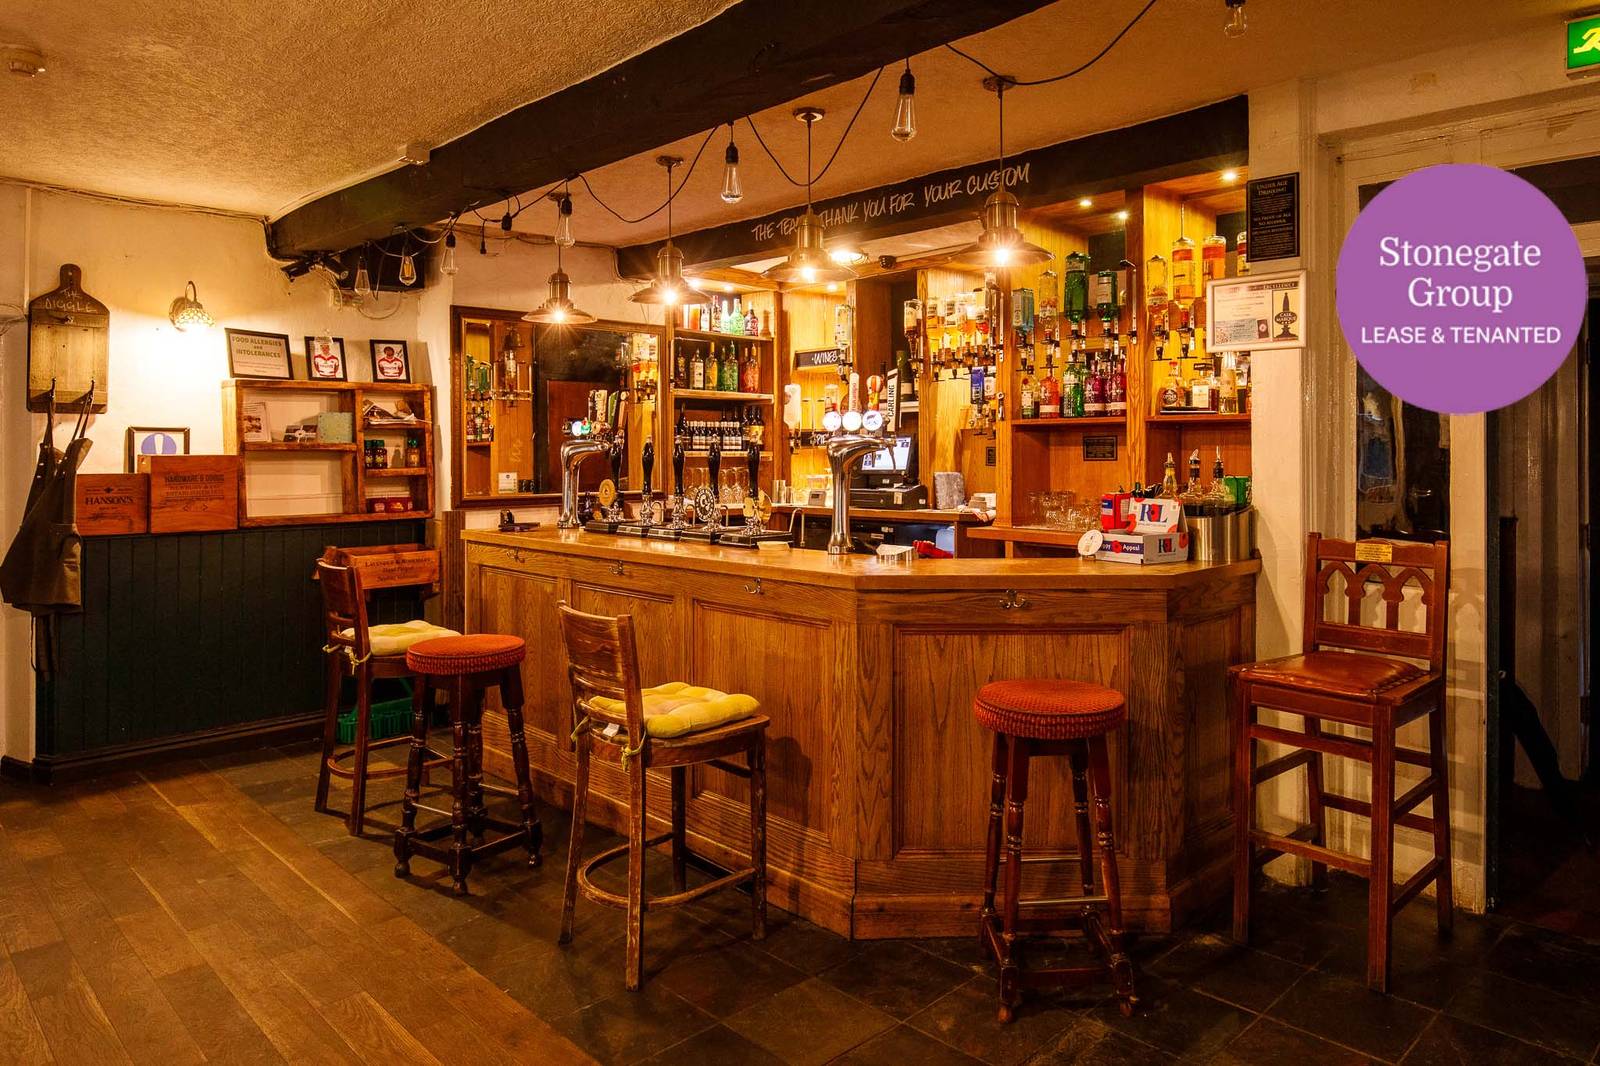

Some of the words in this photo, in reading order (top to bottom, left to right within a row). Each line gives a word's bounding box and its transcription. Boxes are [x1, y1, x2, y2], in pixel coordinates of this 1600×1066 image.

[751, 221, 776, 241] THE
[819, 202, 859, 231] THANK
[863, 196, 886, 222] YOU
[889, 191, 915, 215] FOR
[924, 179, 963, 208] YOUR
[966, 162, 1031, 196] CUSTOM
[45, 298, 97, 313] DIGGLE
[232, 336, 250, 344] FOOD
[250, 338, 282, 347] ALLERGIES
[237, 349, 281, 358] INTOLERANCES
[887, 384, 895, 418] CARLING
[1122, 543, 1140, 552] Appeal
